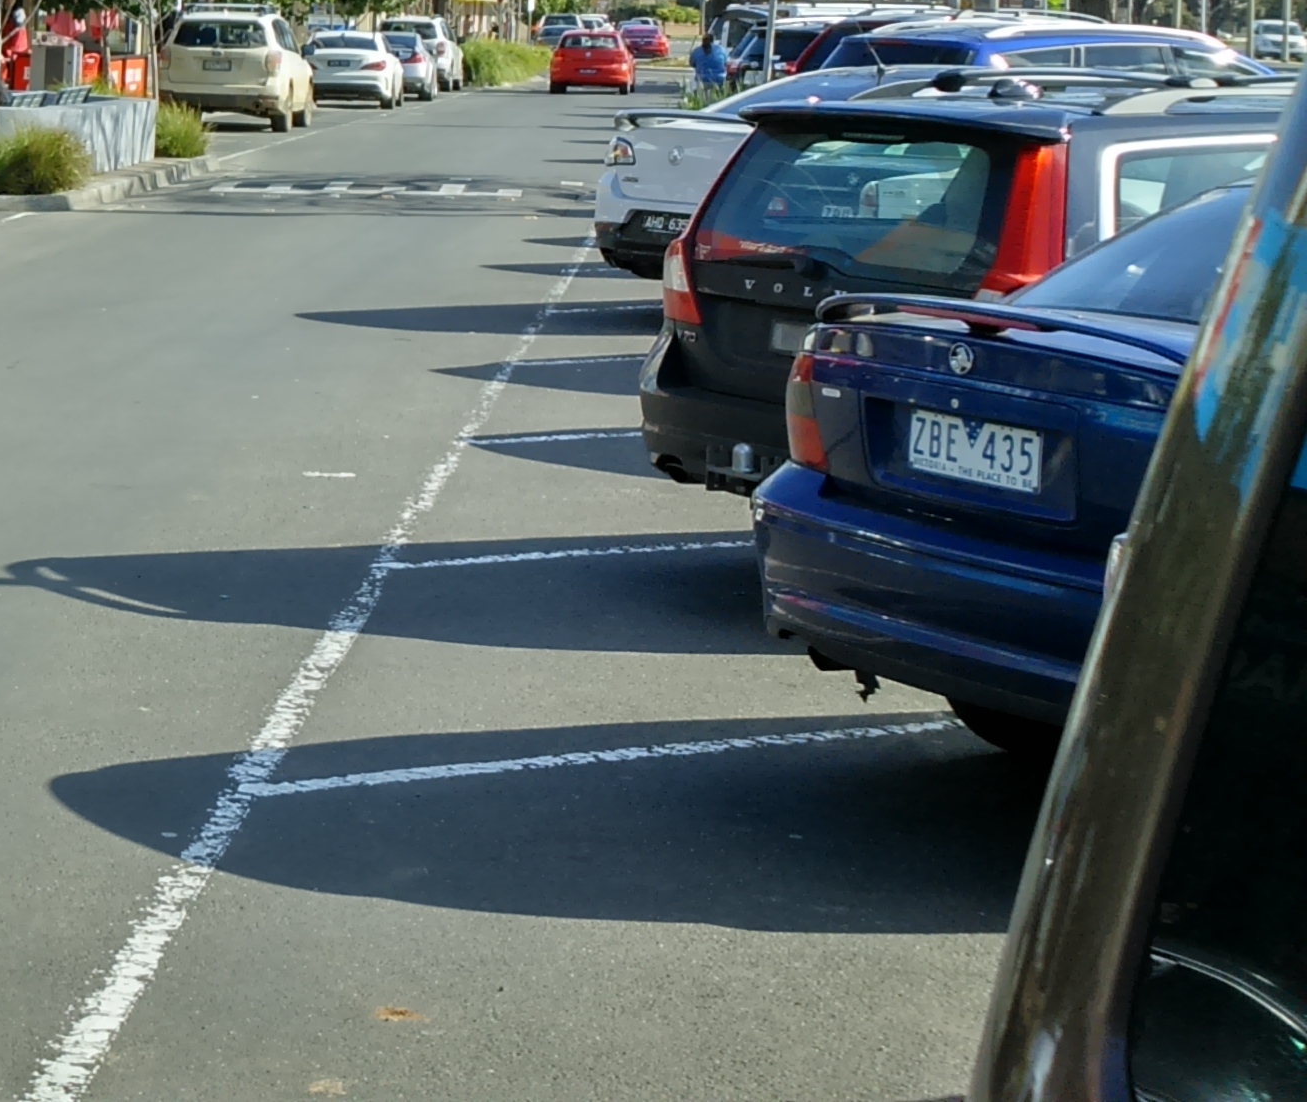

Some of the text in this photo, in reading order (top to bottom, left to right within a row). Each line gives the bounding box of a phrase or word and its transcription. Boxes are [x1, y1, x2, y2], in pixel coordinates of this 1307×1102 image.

[913, 417, 1034, 476] ZBE 435
[912, 456, 1034, 488] VICTORIA THE PLACE TO BE
